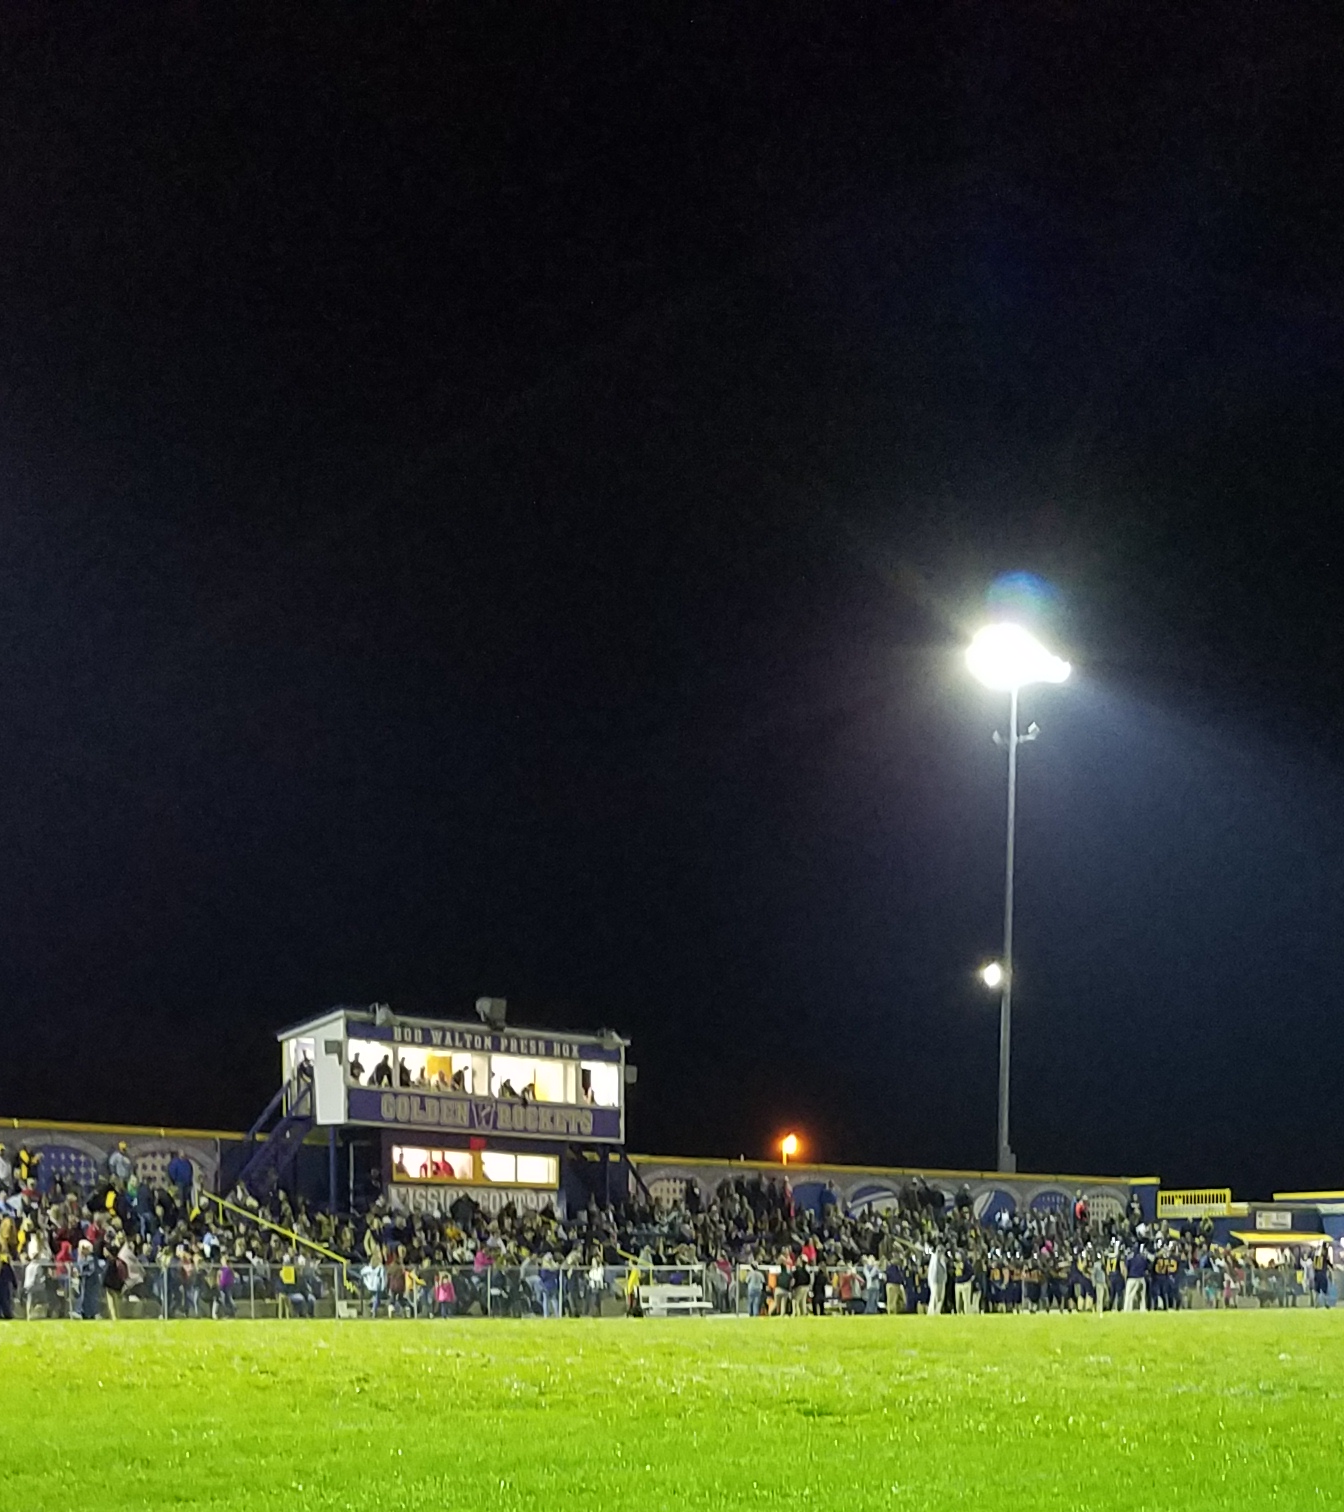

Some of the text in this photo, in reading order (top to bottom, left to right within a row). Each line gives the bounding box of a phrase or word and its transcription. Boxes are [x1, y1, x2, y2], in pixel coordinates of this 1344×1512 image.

[431, 1029, 492, 1051] WALTON
[500, 1035, 546, 1056] PRESS
[381, 1092, 470, 1127] GOLDEN
[496, 1103, 594, 1136] ROCKETS
